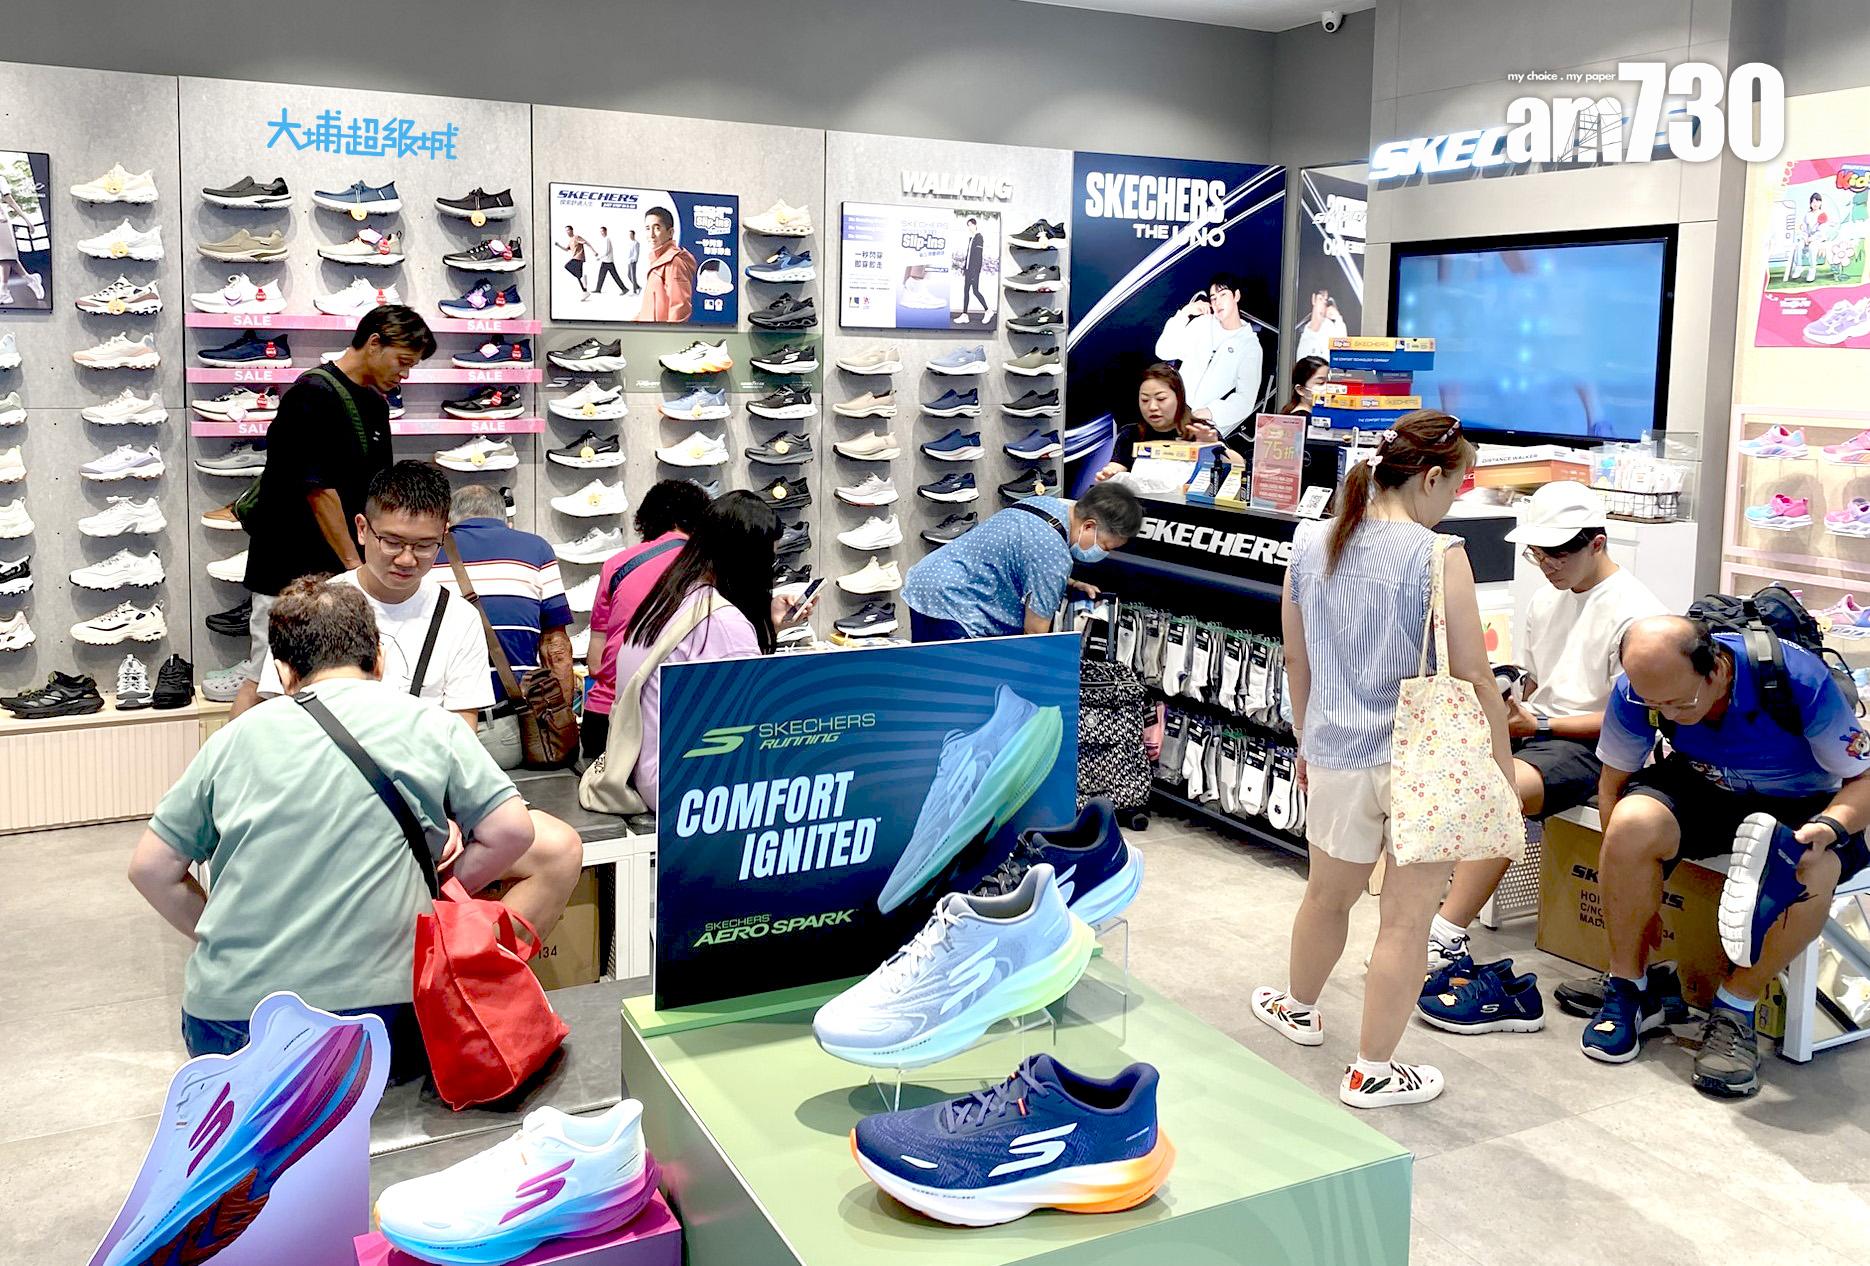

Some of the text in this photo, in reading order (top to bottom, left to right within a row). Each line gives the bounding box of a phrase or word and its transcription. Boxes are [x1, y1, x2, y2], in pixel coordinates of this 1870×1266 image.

[267, 107, 459, 160] 大埔超級城
[901, 169, 1013, 202] WALKING
[1836, 169, 1870, 191] Kid
[557, 189, 639, 203] SKECHERS
[1085, 171, 1227, 224] SKECHERS
[1132, 223, 1169, 239] THE
[233, 315, 272, 326] SALE
[467, 320, 503, 331] SALE
[235, 371, 273, 381] SALE
[468, 371, 503, 382] SALE
[239, 423, 270, 434] SAL
[471, 422, 506, 432] SALE
[1136, 516, 1294, 567] SKECHERS
[759, 713, 876, 738] SKECHERS
[676, 771, 855, 838] COMFORT
[738, 817, 879, 881] IGNITED
[693, 909, 856, 947] AERO SPARK
[705, 914, 771, 932] SKECHERS
